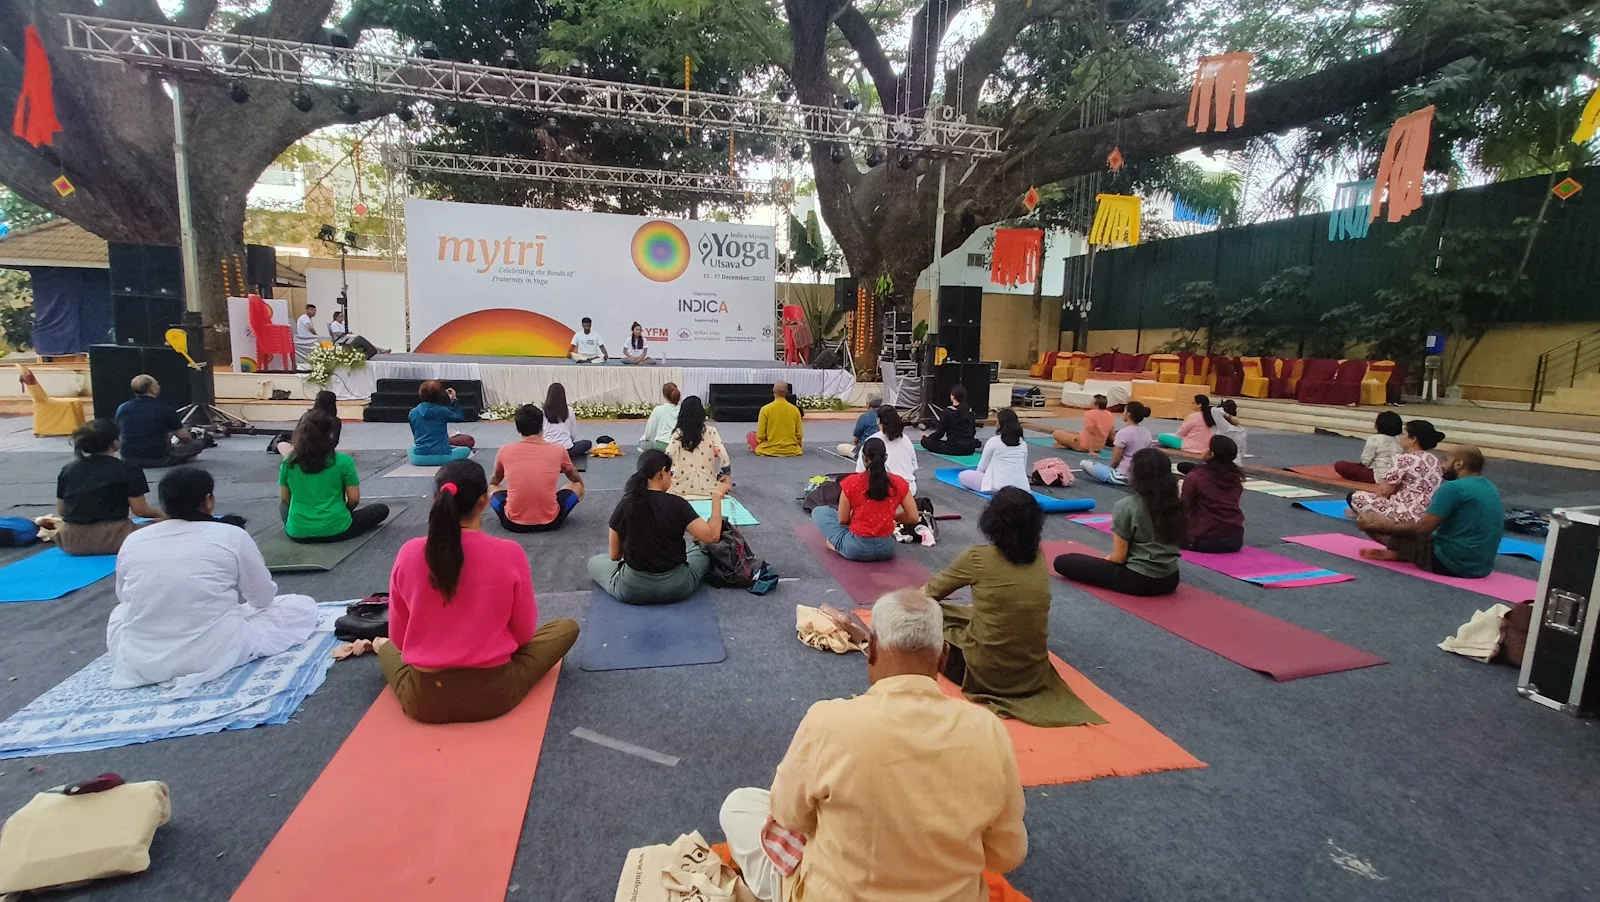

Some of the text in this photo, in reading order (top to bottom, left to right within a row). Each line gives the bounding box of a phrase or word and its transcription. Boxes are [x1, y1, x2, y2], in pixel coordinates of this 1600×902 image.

[437, 235, 548, 274] mytrī
[711, 233, 771, 267] Yoga
[709, 258, 741, 269] Utsava
[498, 267, 535, 276] Celebrating
[535, 268, 546, 276] the
[566, 270, 574, 278] of
[491, 275, 524, 284] Fraternity
[532, 277, 548, 285] Yoga
[678, 299, 729, 313] INDICA
[645, 327, 669, 337] YFM
